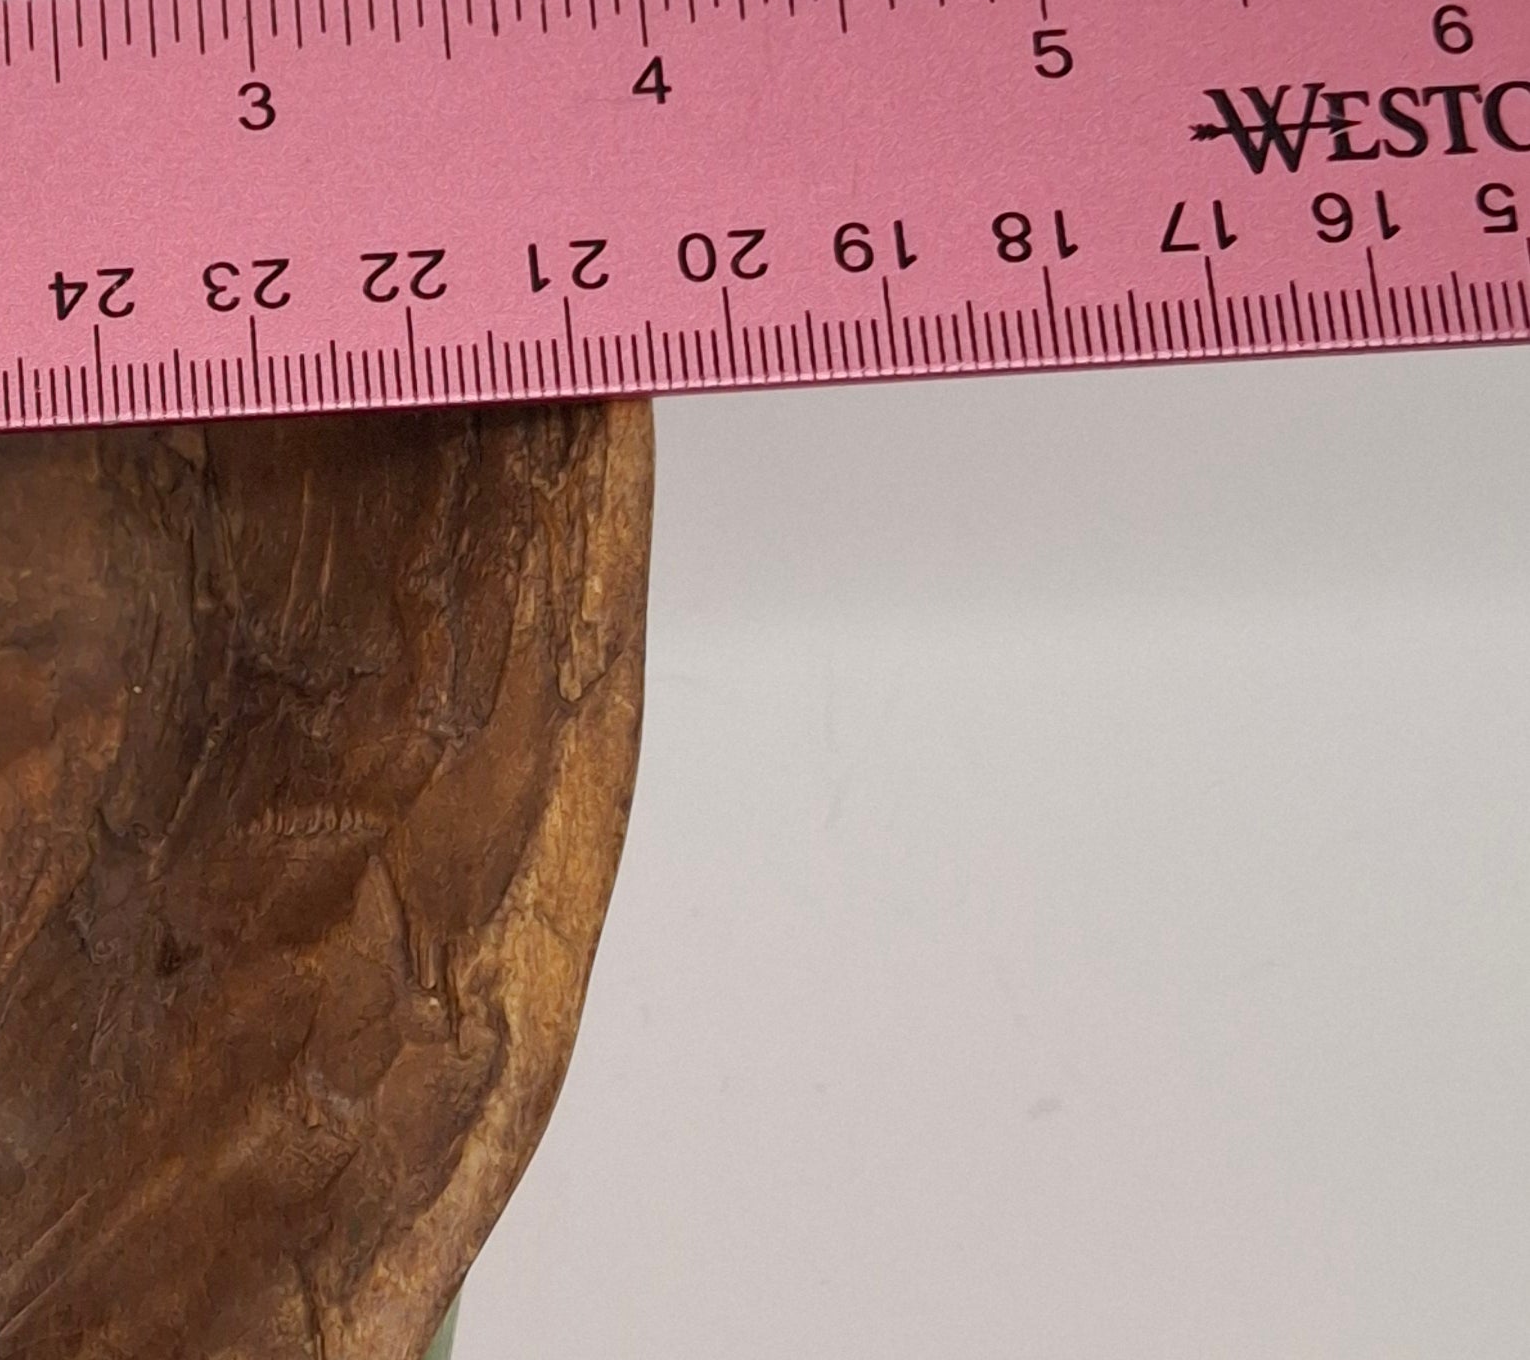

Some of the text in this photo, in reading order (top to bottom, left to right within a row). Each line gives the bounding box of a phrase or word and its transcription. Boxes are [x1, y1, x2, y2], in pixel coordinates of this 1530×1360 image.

[237, 81, 277, 131] 3
[632, 56, 673, 105] 4
[1032, 29, 1074, 79] 5
[1432, 4, 1474, 55] 6
[992, 209, 1079, 263] 18
[1160, 199, 1238, 252] 17
[1311, 189, 1402, 243] 16
[528, 238, 610, 293] 21
[678, 228, 769, 282] 20
[834, 219, 918, 273] 19
[47, 267, 136, 322] 24
[201, 258, 292, 312] 23
[360, 248, 448, 303] 22
